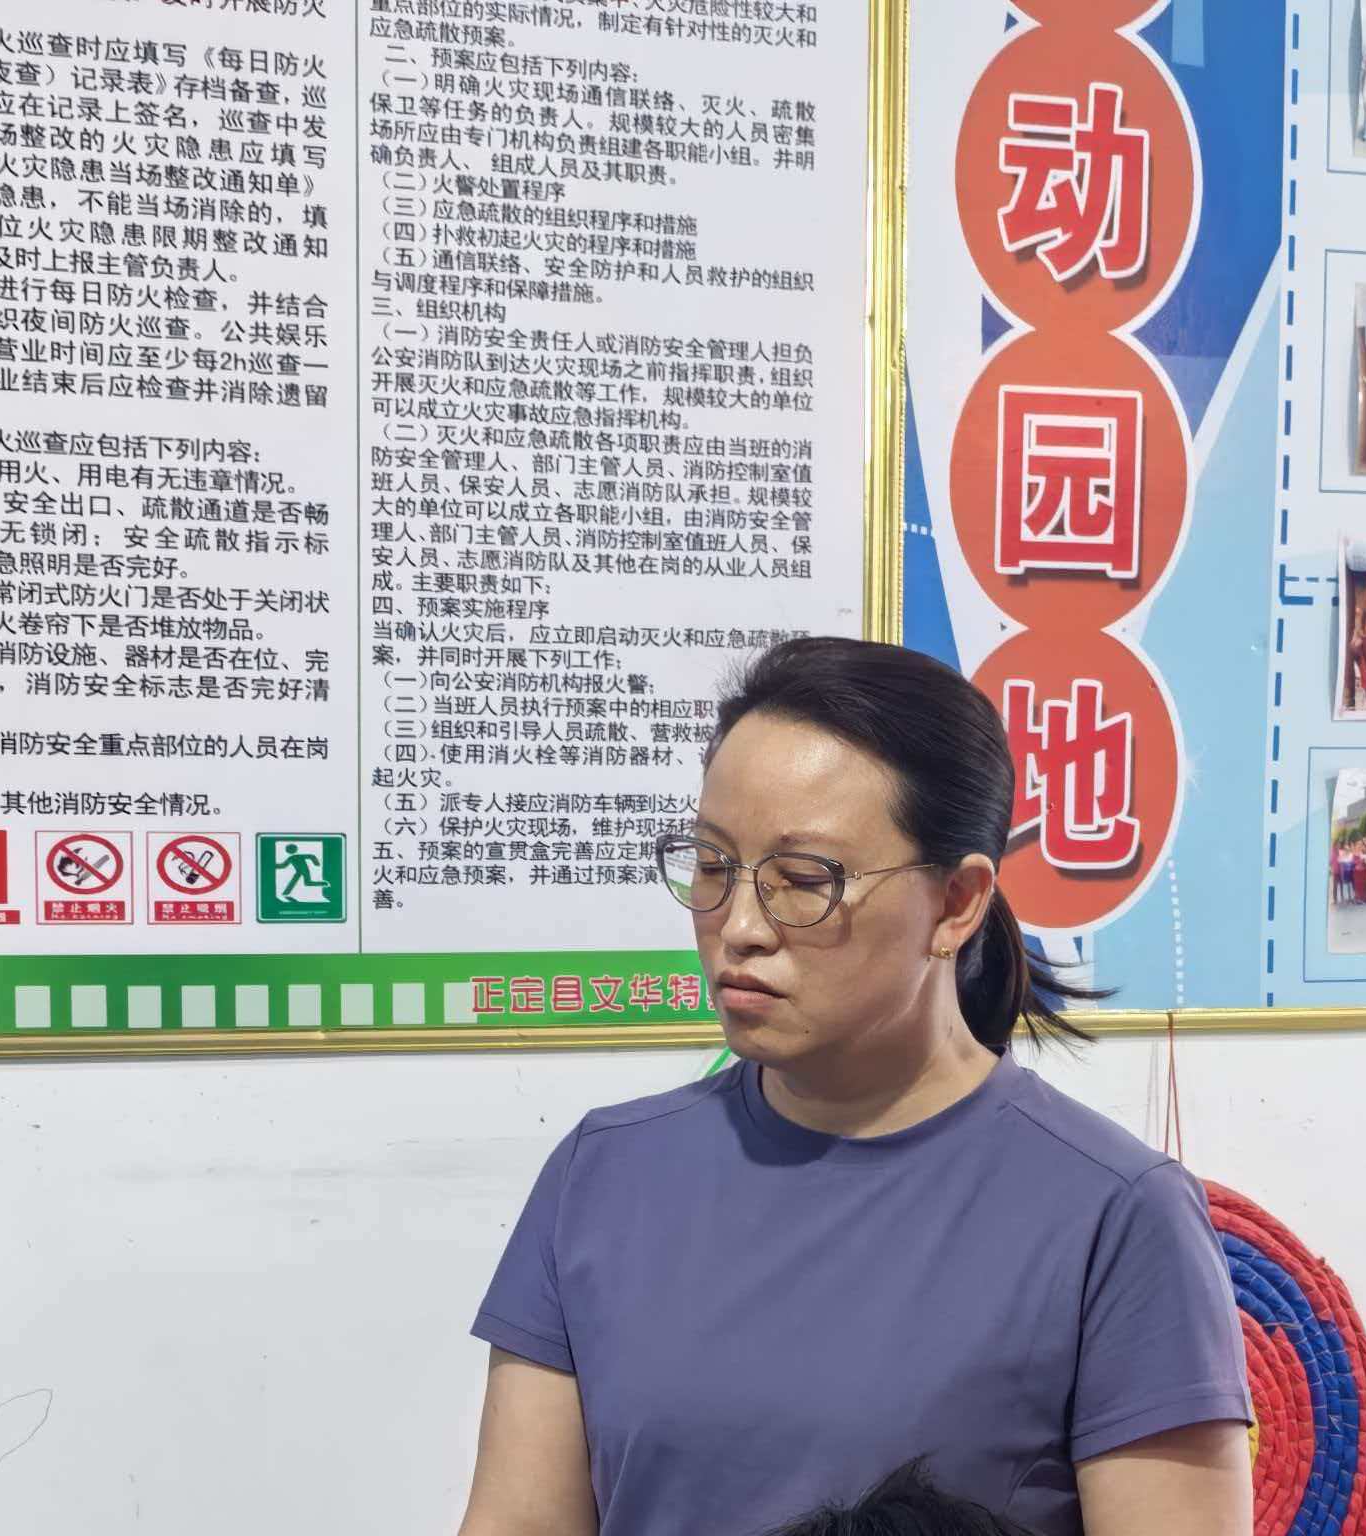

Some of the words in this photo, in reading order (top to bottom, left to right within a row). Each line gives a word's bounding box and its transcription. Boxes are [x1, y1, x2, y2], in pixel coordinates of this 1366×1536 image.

[371, 300, 506, 323] 三、组织机构
[372, 597, 550, 621] 四、预案实施程序
[372, 768, 453, 790] 起火灾。
[373, 889, 404, 909] 善。
